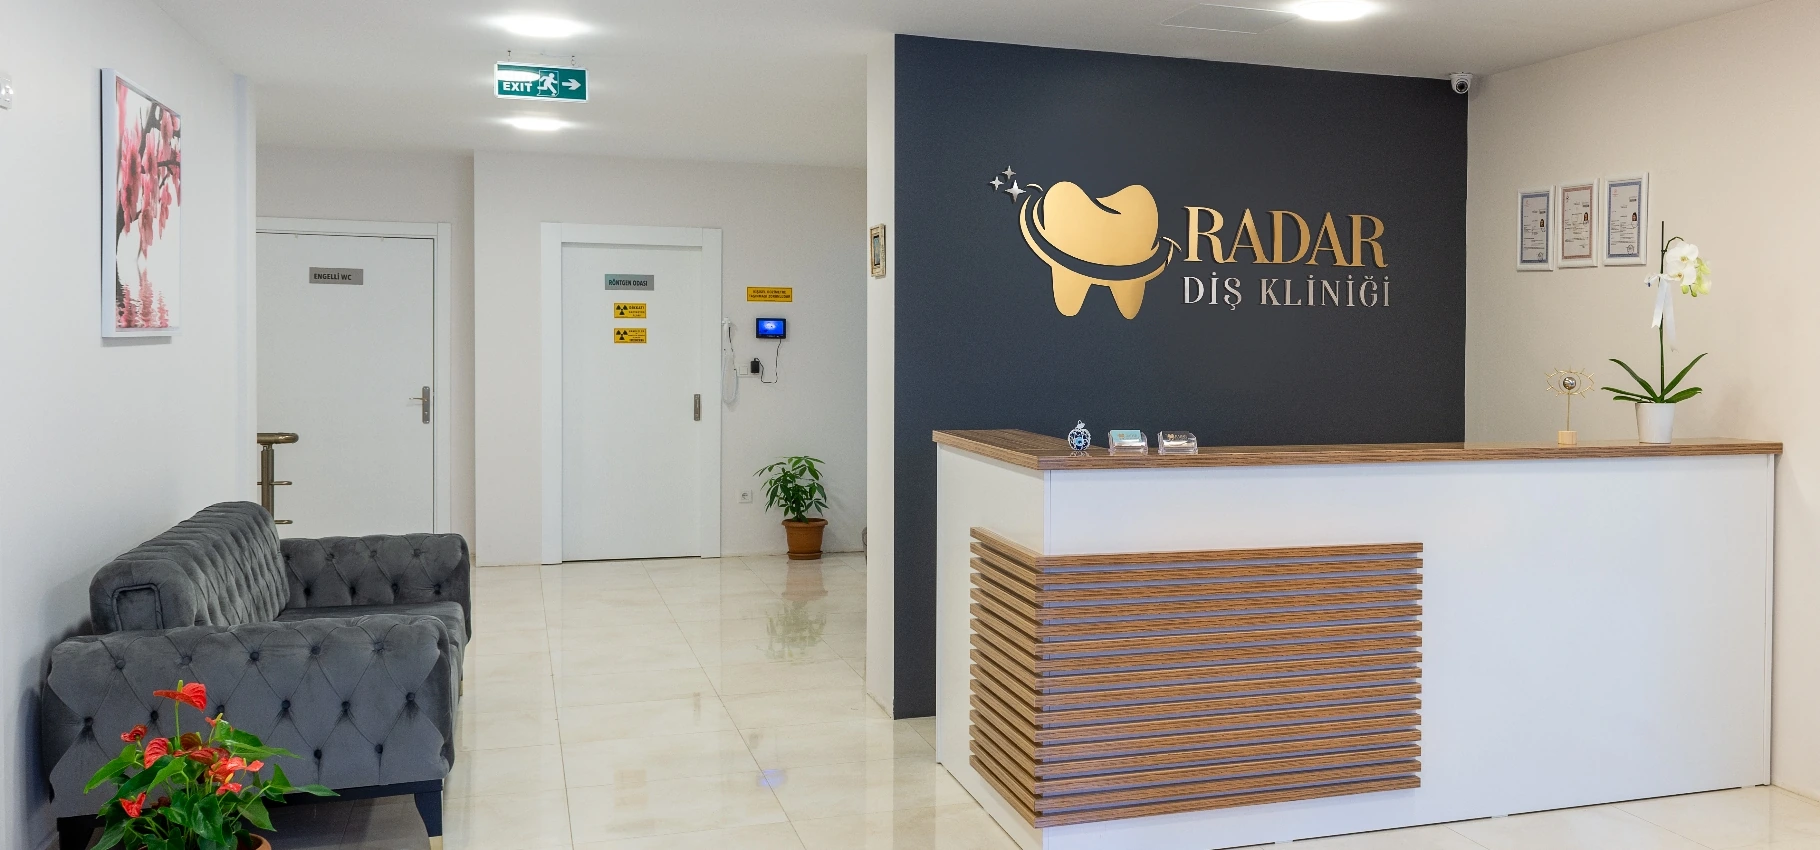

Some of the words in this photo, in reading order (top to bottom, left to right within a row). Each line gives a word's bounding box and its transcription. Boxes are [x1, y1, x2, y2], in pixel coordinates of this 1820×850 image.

[503, 82, 532, 92] EXIT
[1183, 205, 1389, 268] RADAR
[314, 272, 340, 280] ENGELLİ
[608, 278, 631, 286] RÖNTGEN
[1183, 271, 1243, 310] DİŞ
[1260, 273, 1391, 307] KLİNİĞİ
